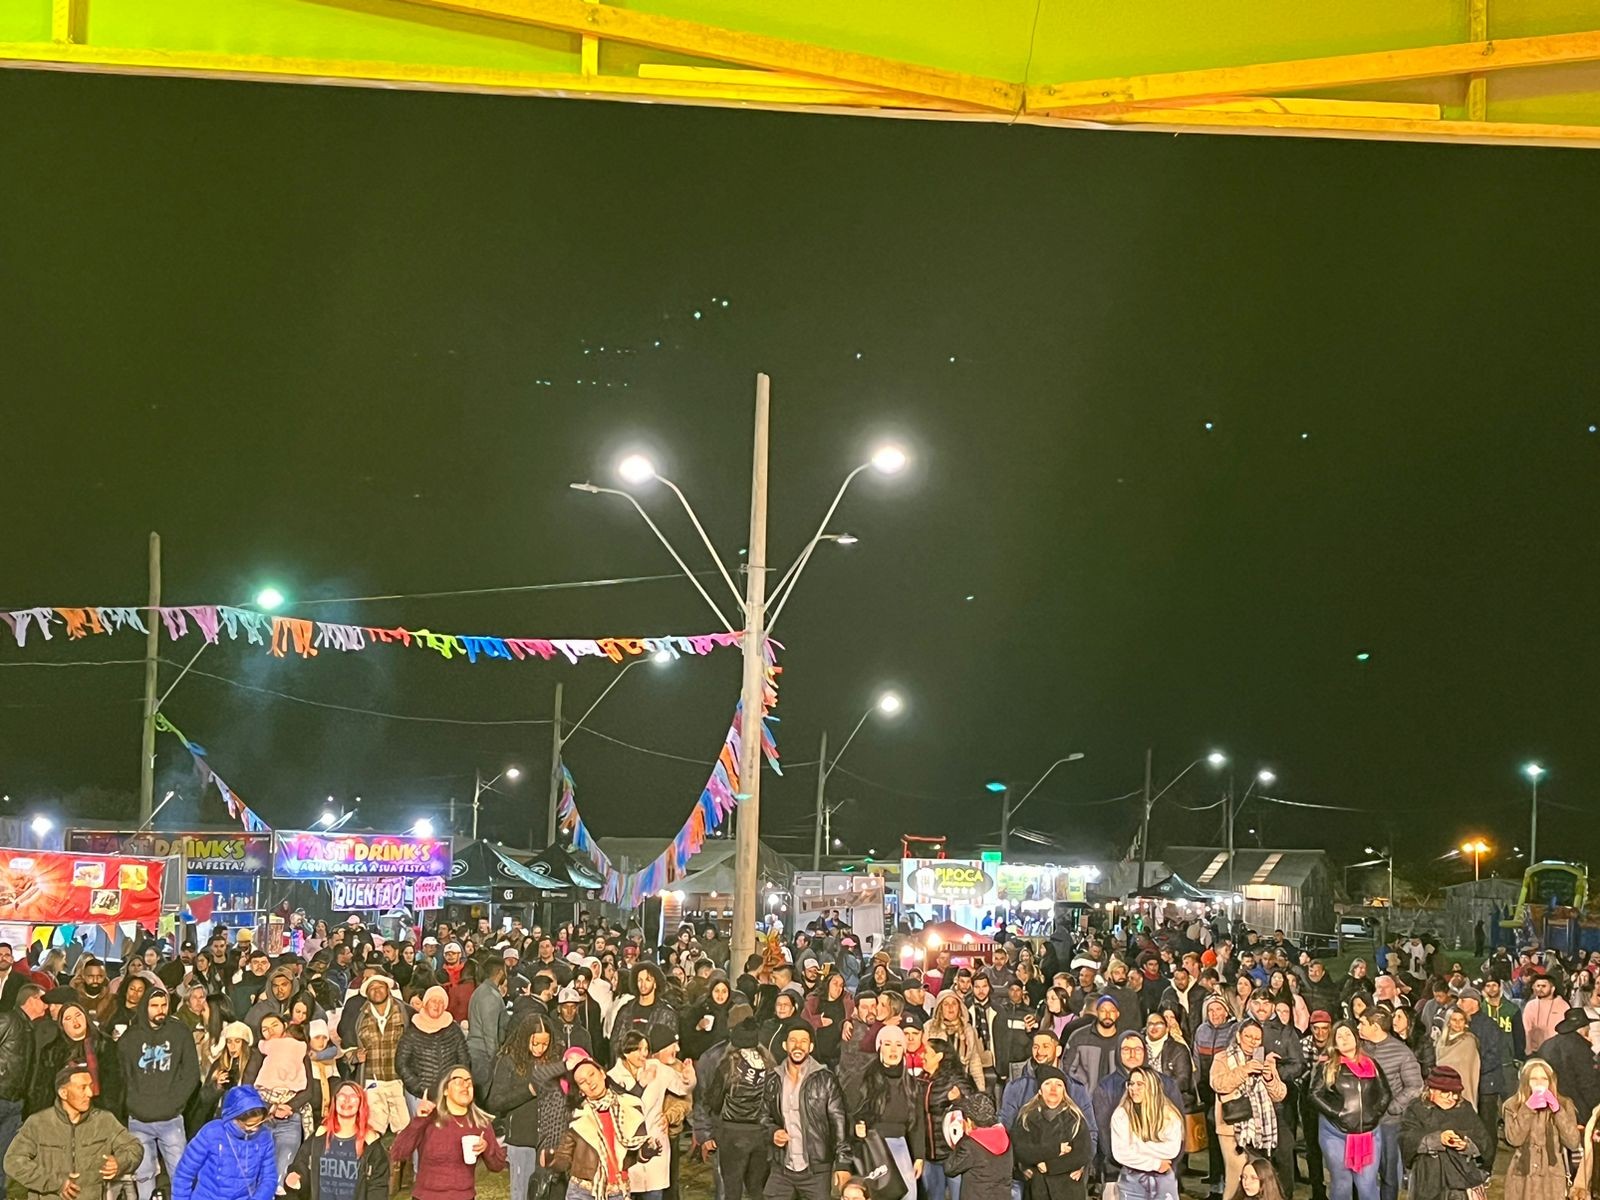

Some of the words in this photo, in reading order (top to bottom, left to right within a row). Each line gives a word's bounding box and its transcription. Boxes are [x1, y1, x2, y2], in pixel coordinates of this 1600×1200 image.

[298, 840, 348, 860] FAST
[355, 843, 431, 861] DRINK'S
[187, 861, 203, 870] UA
[206, 861, 245, 870] FESTA!
[935, 867, 984, 882] PIPOCA
